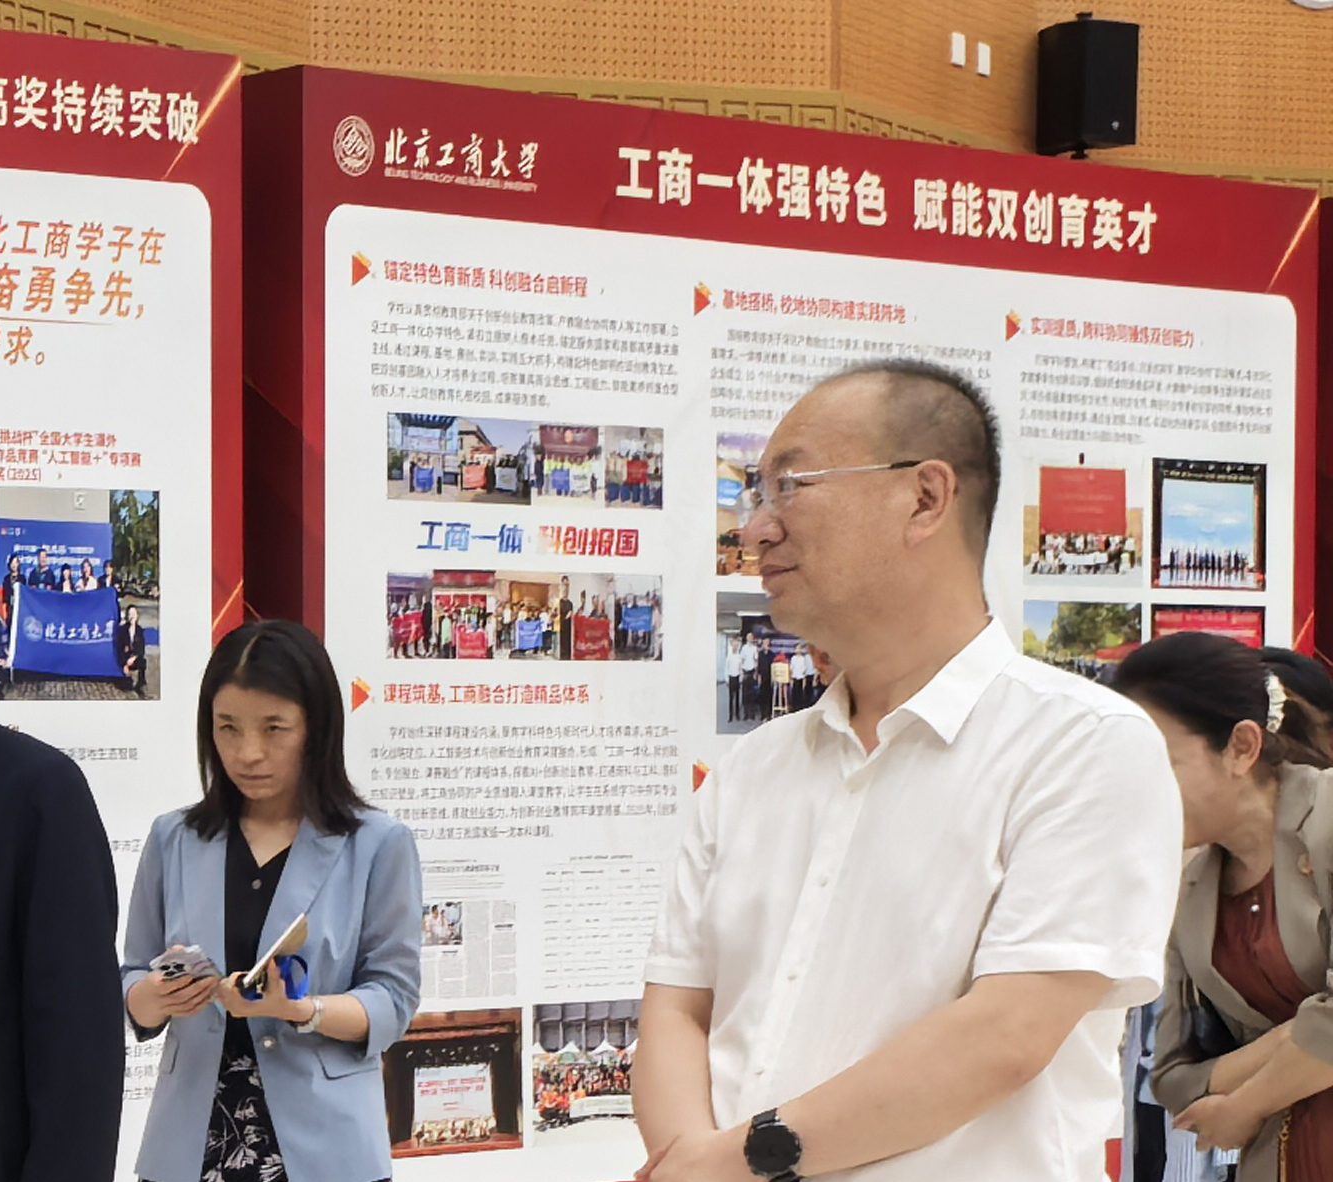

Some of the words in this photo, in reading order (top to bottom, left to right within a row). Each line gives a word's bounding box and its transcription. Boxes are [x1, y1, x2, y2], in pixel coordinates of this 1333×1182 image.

[385, 127, 538, 179] 北京工商大学
[615, 146, 887, 227] 工商一体强特色
[913, 177, 1158, 254] 赋能双创育英才
[416, 521, 524, 554] 工商一体
